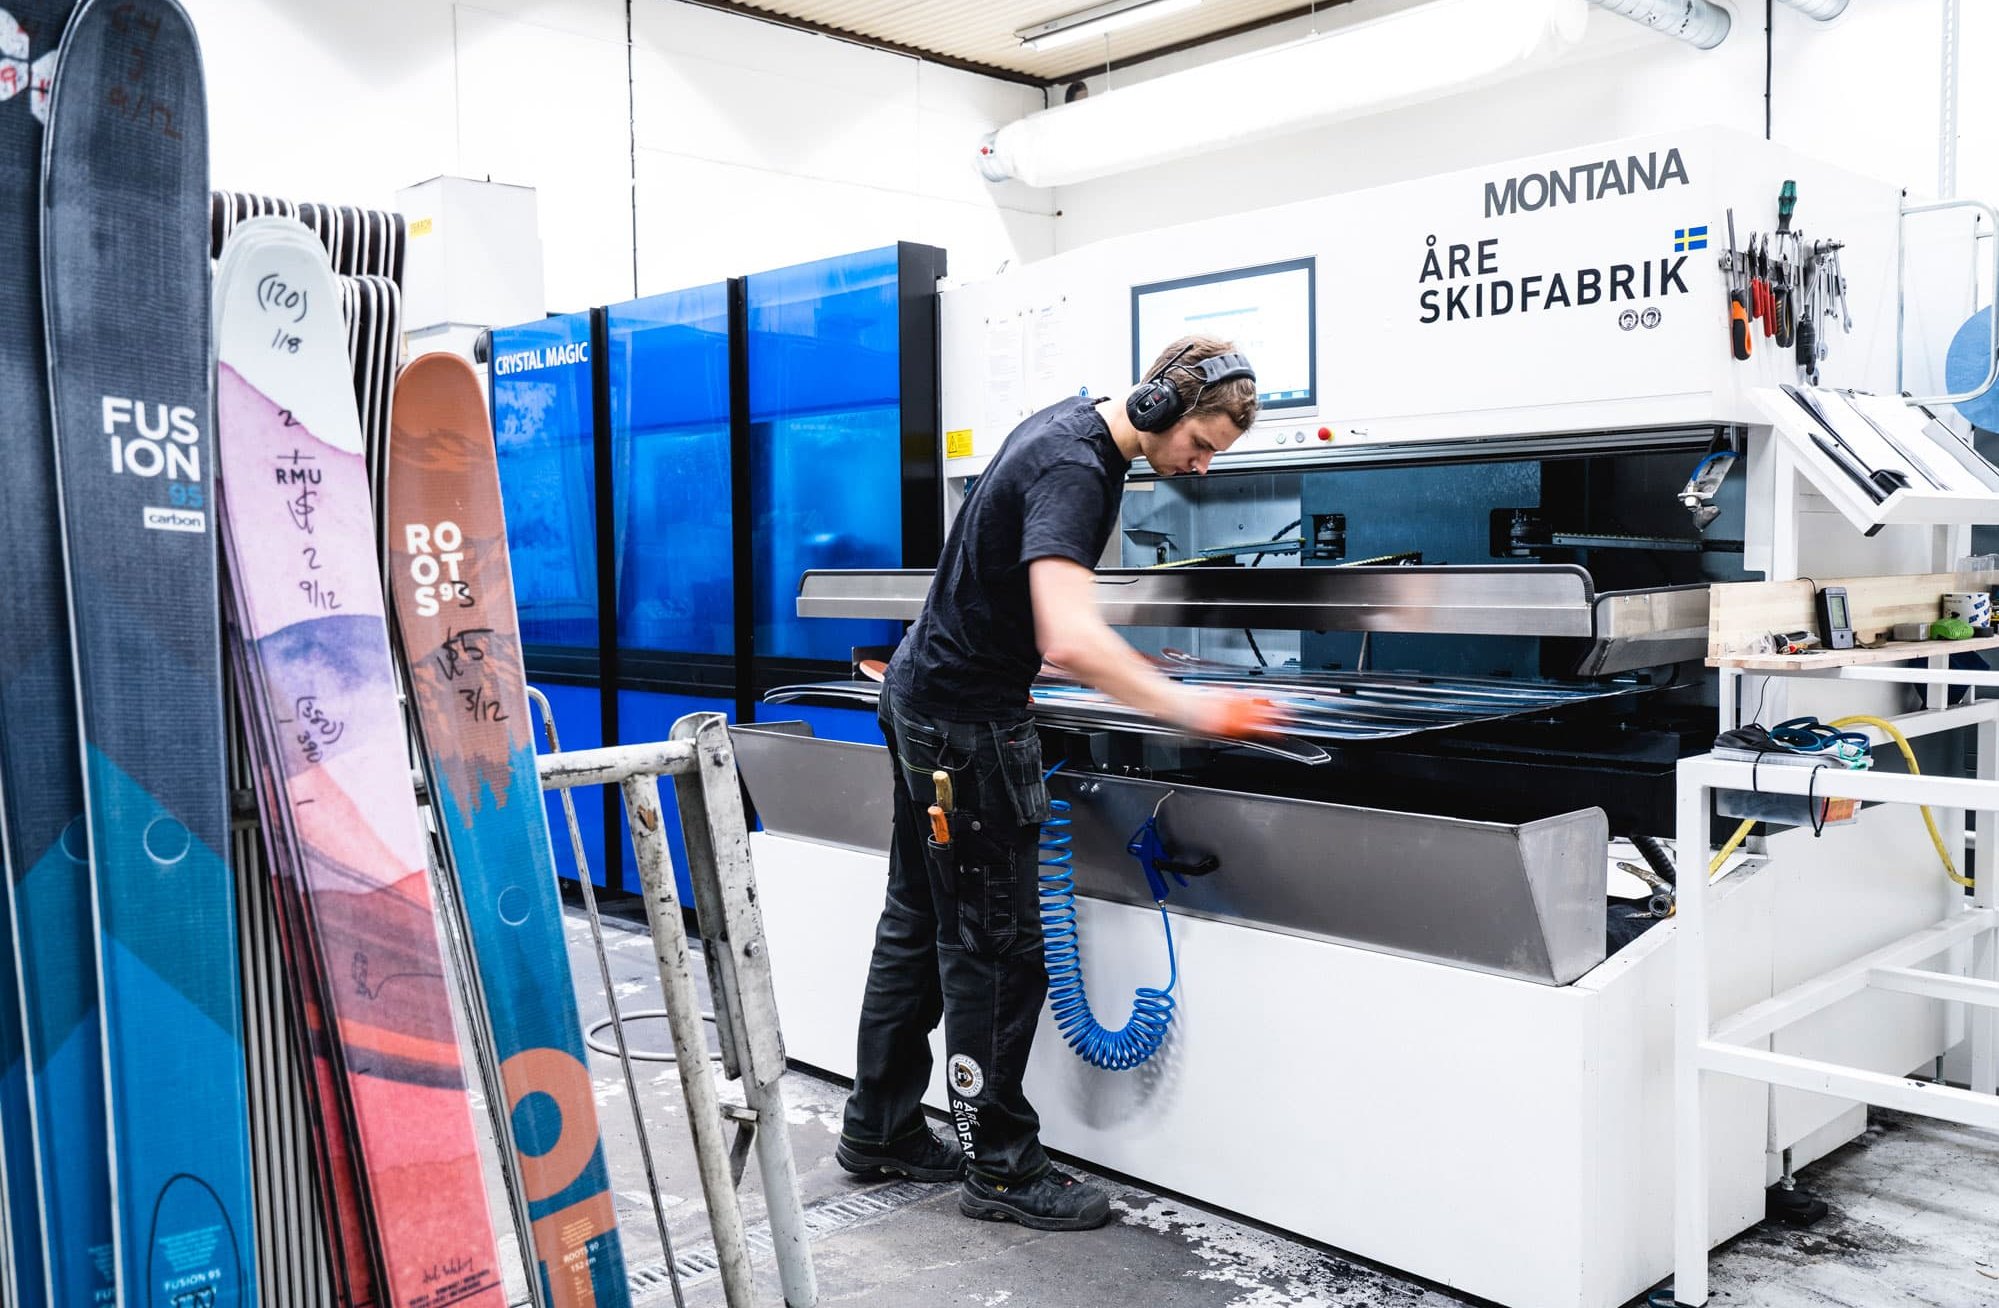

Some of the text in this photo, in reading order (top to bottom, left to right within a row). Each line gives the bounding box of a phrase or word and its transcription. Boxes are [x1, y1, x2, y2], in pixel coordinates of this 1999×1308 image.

[1484, 147, 1690, 218] MONTANA
[1419, 234, 1499, 284] ÅRE
[1418, 255, 1690, 325] SKIDFABRIK
[495, 341, 588, 376] CRYSTAL MAGIC
[102, 395, 200, 445] FUS
[278, 409, 301, 428] 2
[110, 434, 201, 482] ION
[275, 467, 323, 485] RMU
[168, 481, 204, 508] 95
[149, 512, 201, 528] carbon
[404, 520, 463, 555] RO
[303, 547, 322, 570] 2
[299, 579, 343, 610] 9/12
[458, 686, 509, 723] 3/12
[963, 1101, 981, 1130] ÅRE
[563, 1241, 600, 1264] ROOTS 90
[164, 1267, 222, 1291] FUSION 95
